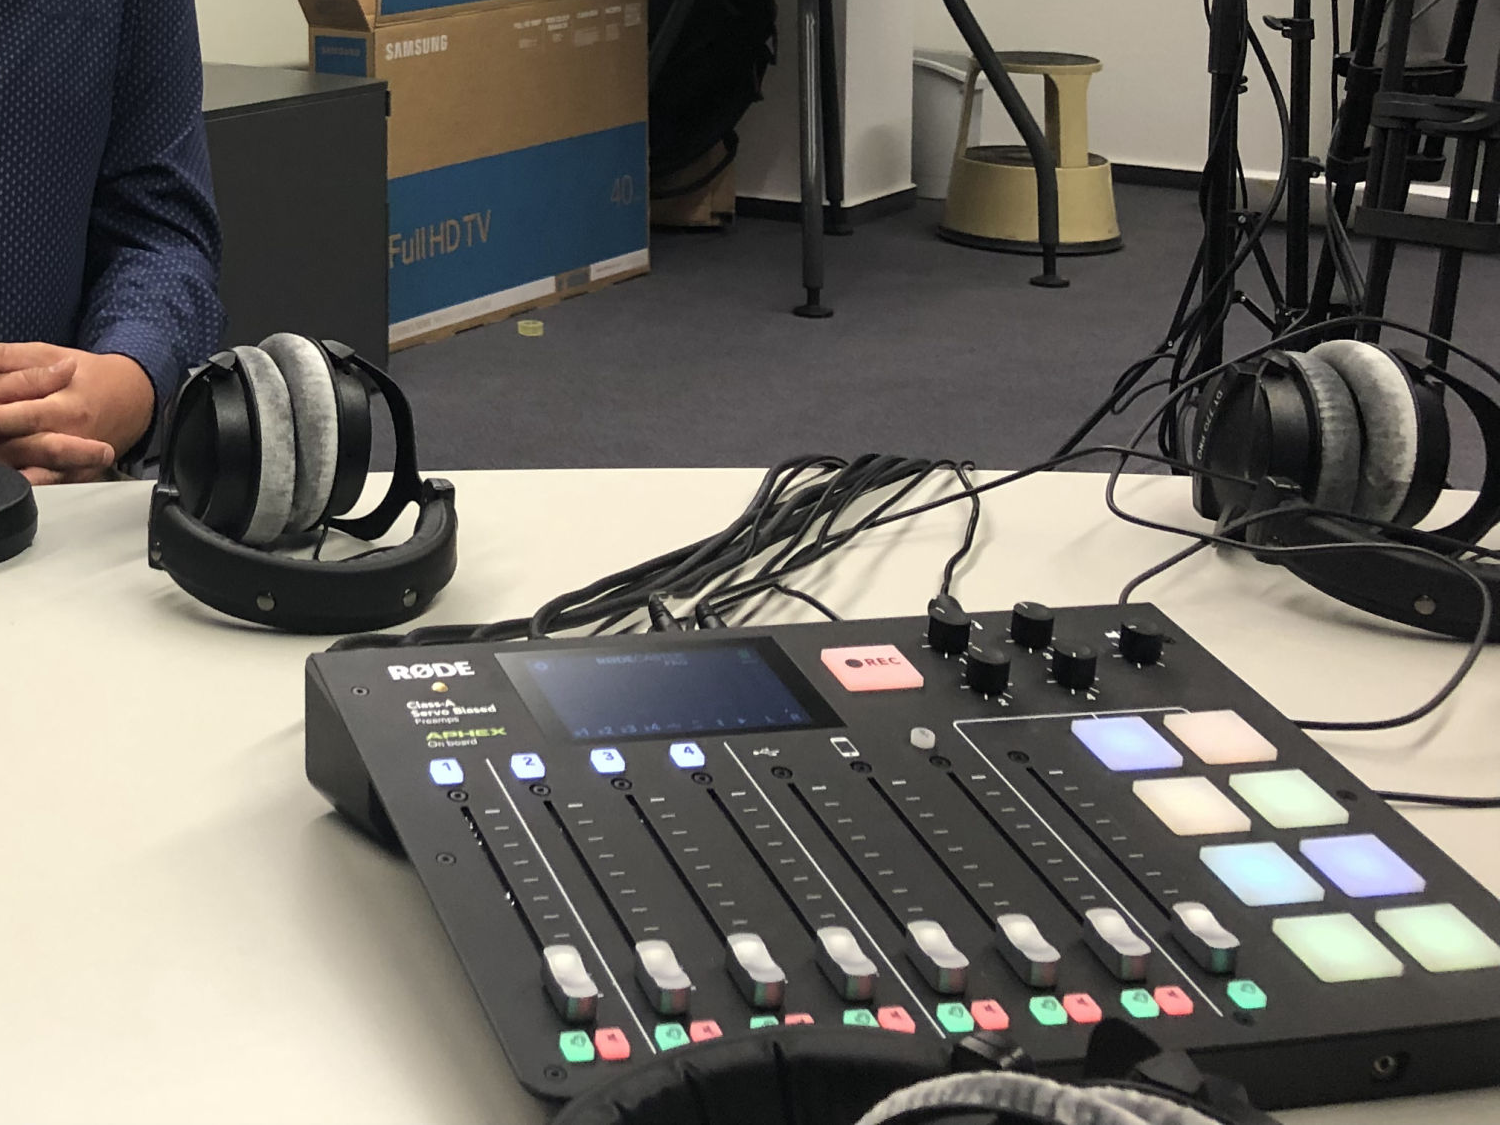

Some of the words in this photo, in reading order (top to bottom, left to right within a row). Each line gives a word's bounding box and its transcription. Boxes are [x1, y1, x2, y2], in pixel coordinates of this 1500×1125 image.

[385, 34, 449, 61] SAMSUNG
[610, 174, 634, 206] 40
[388, 226, 427, 269] Full
[429, 218, 462, 257] HD
[462, 209, 492, 248] TV
[863, 657, 902, 667] REC
[387, 660, 476, 681] RØDE
[406, 698, 457, 710] Class-A
[410, 708, 451, 718] Servo
[426, 726, 508, 742] APHEX
[603, 751, 615, 761] 3
[683, 745, 695, 756] 4
[523, 756, 536, 767] 2
